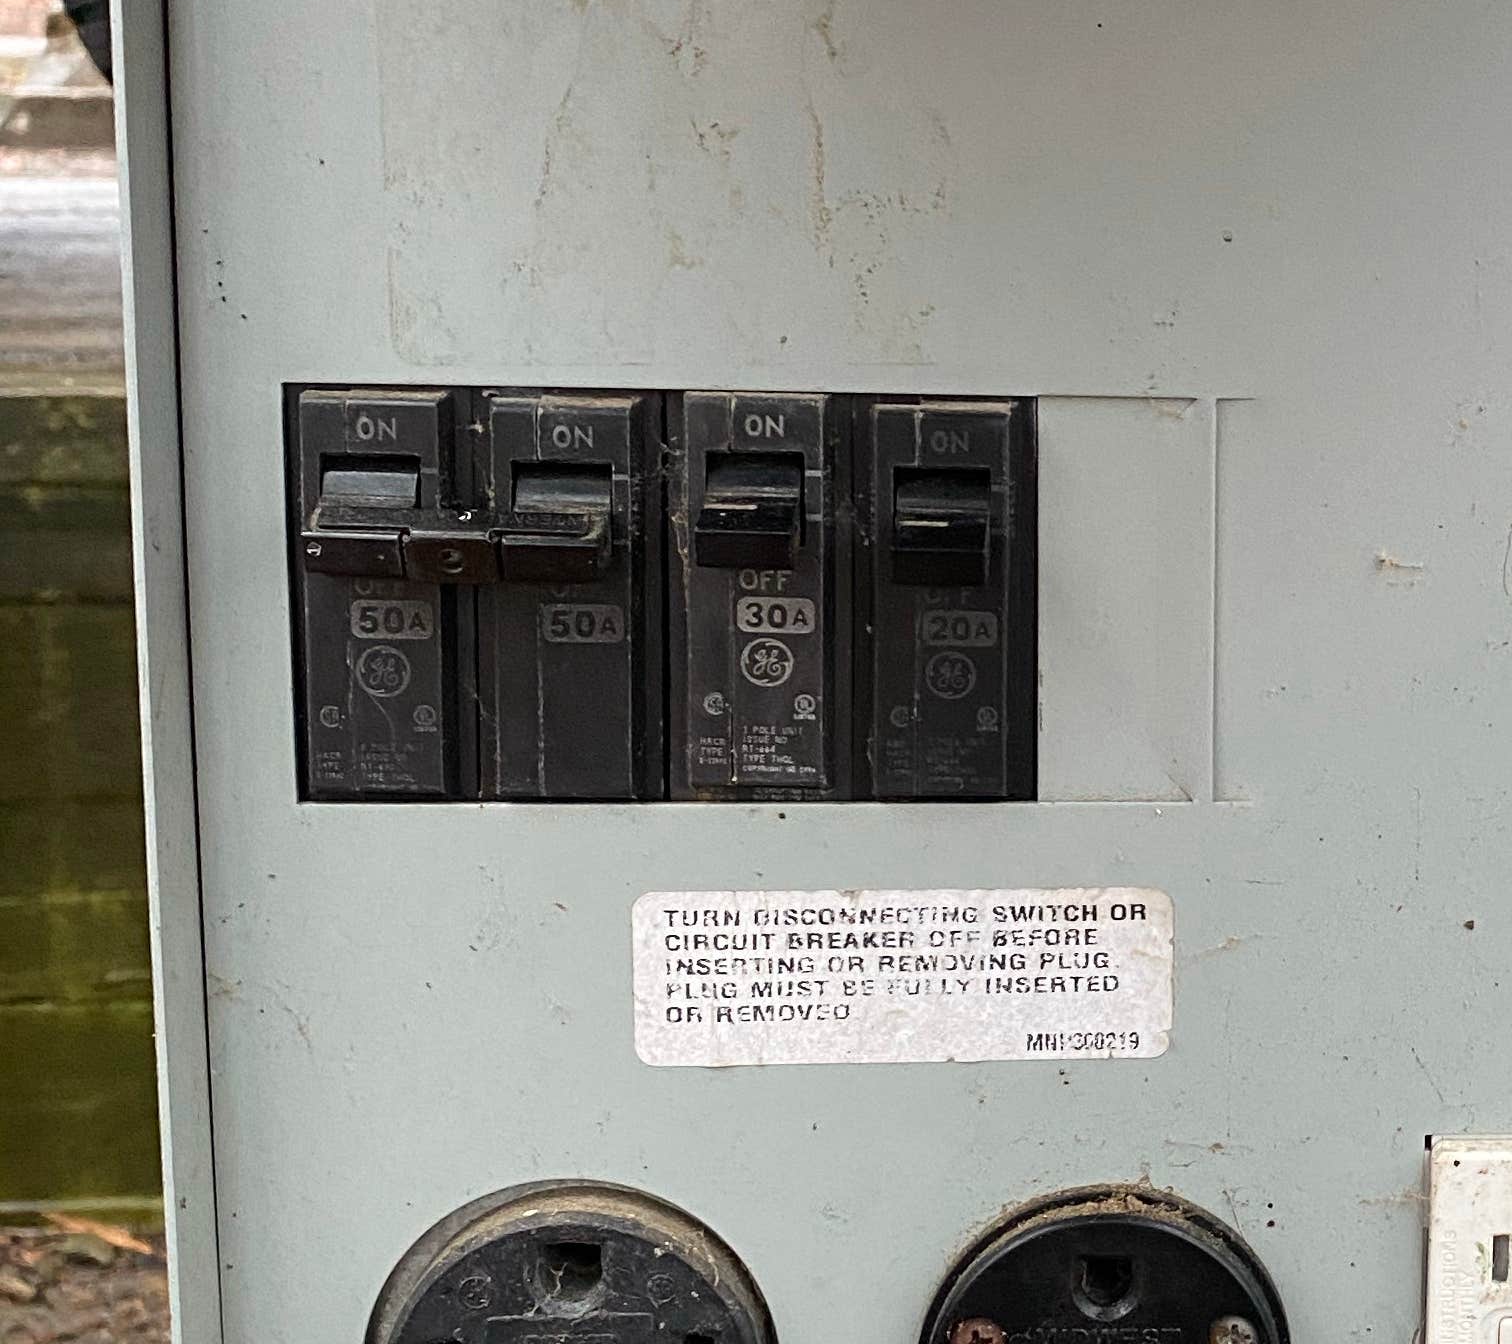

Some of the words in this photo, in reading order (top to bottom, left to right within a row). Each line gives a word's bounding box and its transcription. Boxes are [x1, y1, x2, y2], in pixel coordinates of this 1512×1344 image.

[355, 416, 397, 440] ON
[553, 424, 594, 449] ON
[745, 414, 785, 438] ON
[930, 431, 970, 453] ON
[739, 570, 792, 590] OFF
[357, 606, 428, 634] 50A
[549, 608, 617, 638] 50A
[745, 602, 808, 629] 30A
[928, 616, 991, 641] 20A
[664, 909, 741, 927] TURN
[754, 906, 978, 926] DISCONNECTING
[993, 904, 1098, 923] SWITCH
[1110, 903, 1147, 921] OR
[664, 932, 777, 951] CIRCUIT
[788, 931, 915, 950] BREAKER
[929, 930, 981, 947] OFF
[993, 928, 1098, 947] BEFORE
[666, 956, 815, 976] INSERTING
[828, 955, 865, 974] OR
[878, 953, 1026, 973] REMOVING
[666, 982, 737, 1000] PLUG
[751, 980, 829, 999] MUST
[843, 979, 875, 997] BE
[986, 974, 1120, 994] INSERTED
[666, 1006, 703, 1024] OR
[716, 1004, 851, 1024] REMOVED
[1458, 1270, 1474, 1344] MONTHLY
